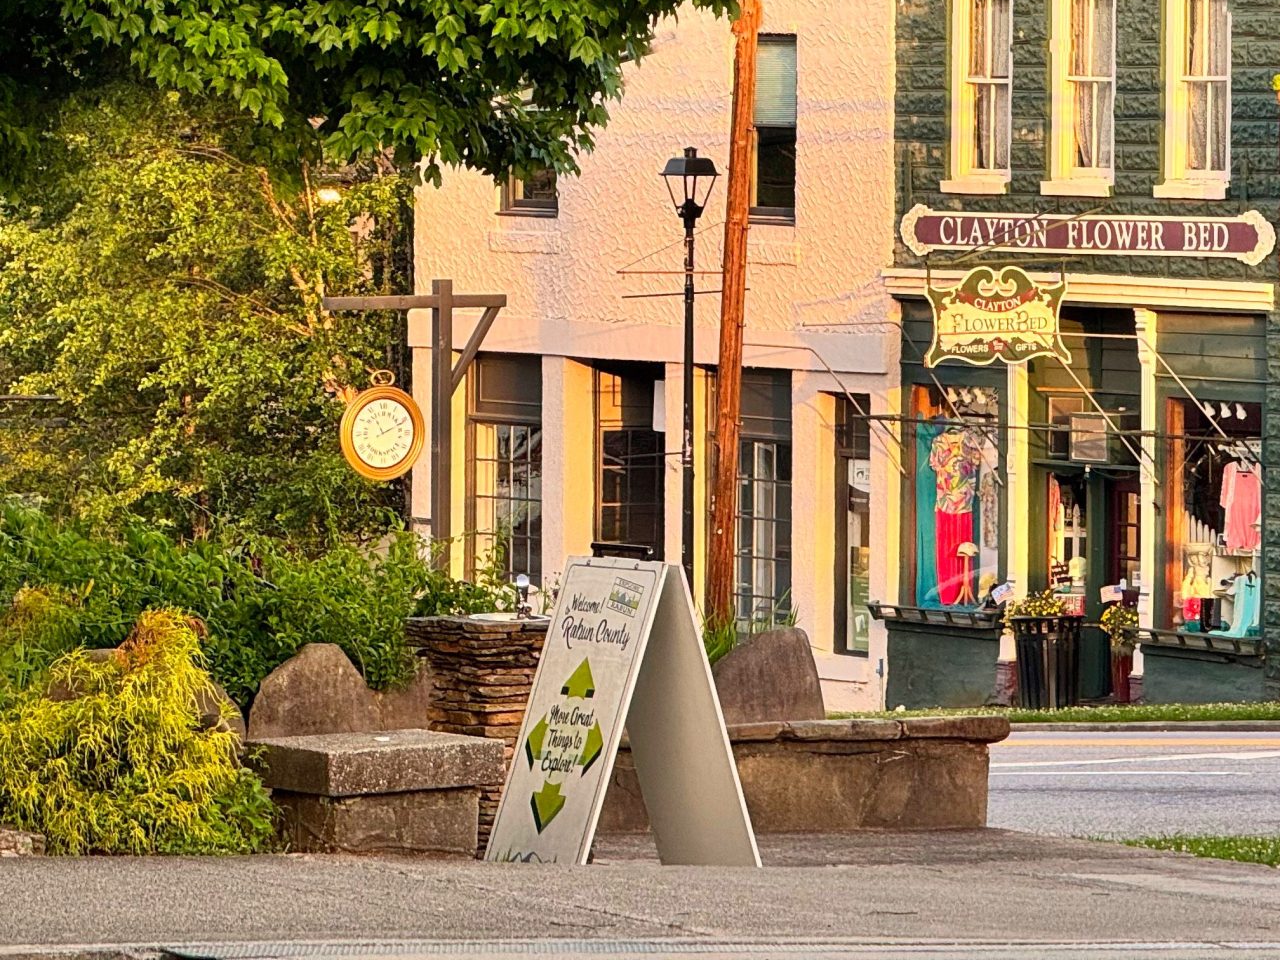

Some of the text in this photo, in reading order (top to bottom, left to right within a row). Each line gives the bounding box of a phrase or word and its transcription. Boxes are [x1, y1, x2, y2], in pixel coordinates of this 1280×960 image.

[939, 217, 1230, 251] CLAYTON FLOWER BED
[974, 296, 1021, 311] CLAYTON
[951, 344, 989, 354] FLOWERS
[1015, 343, 1037, 352] GIFTS
[572, 592, 606, 614] Welcome!
[611, 601, 633, 615] RABUN
[561, 615, 631, 651] Rabun County
[549, 704, 595, 728] More Great
[548, 729, 582, 753] Things to
[541, 750, 579, 779] Explore!
